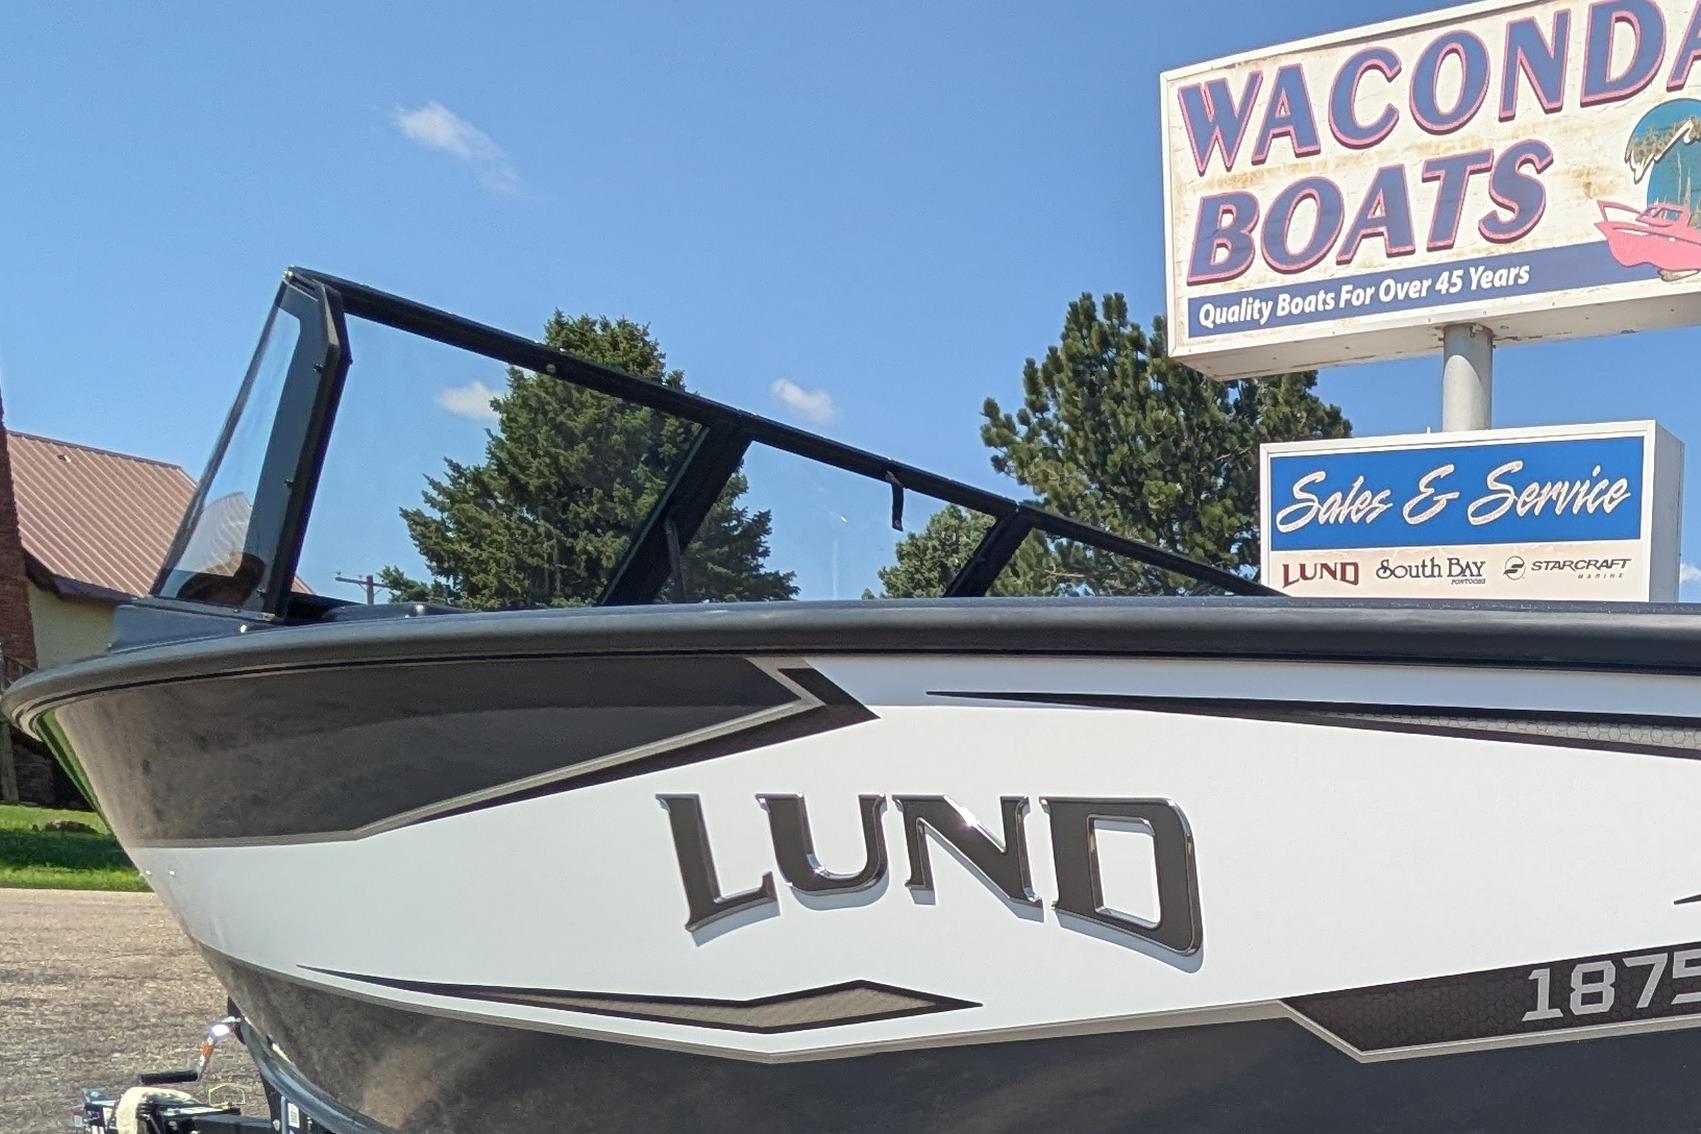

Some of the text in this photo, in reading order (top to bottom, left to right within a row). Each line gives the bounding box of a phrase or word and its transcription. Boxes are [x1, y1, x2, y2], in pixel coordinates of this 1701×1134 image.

[1186, 139, 1554, 285] BOATS
[1199, 263, 1531, 329] Quality Boats For Over 45 Years
[1276, 460, 1632, 534] Sales & Service
[1282, 562, 1359, 588] LUND
[1376, 556, 1443, 579] South
[1531, 558, 1632, 572] STARCRAFT
[655, 792, 1204, 962] LUND
